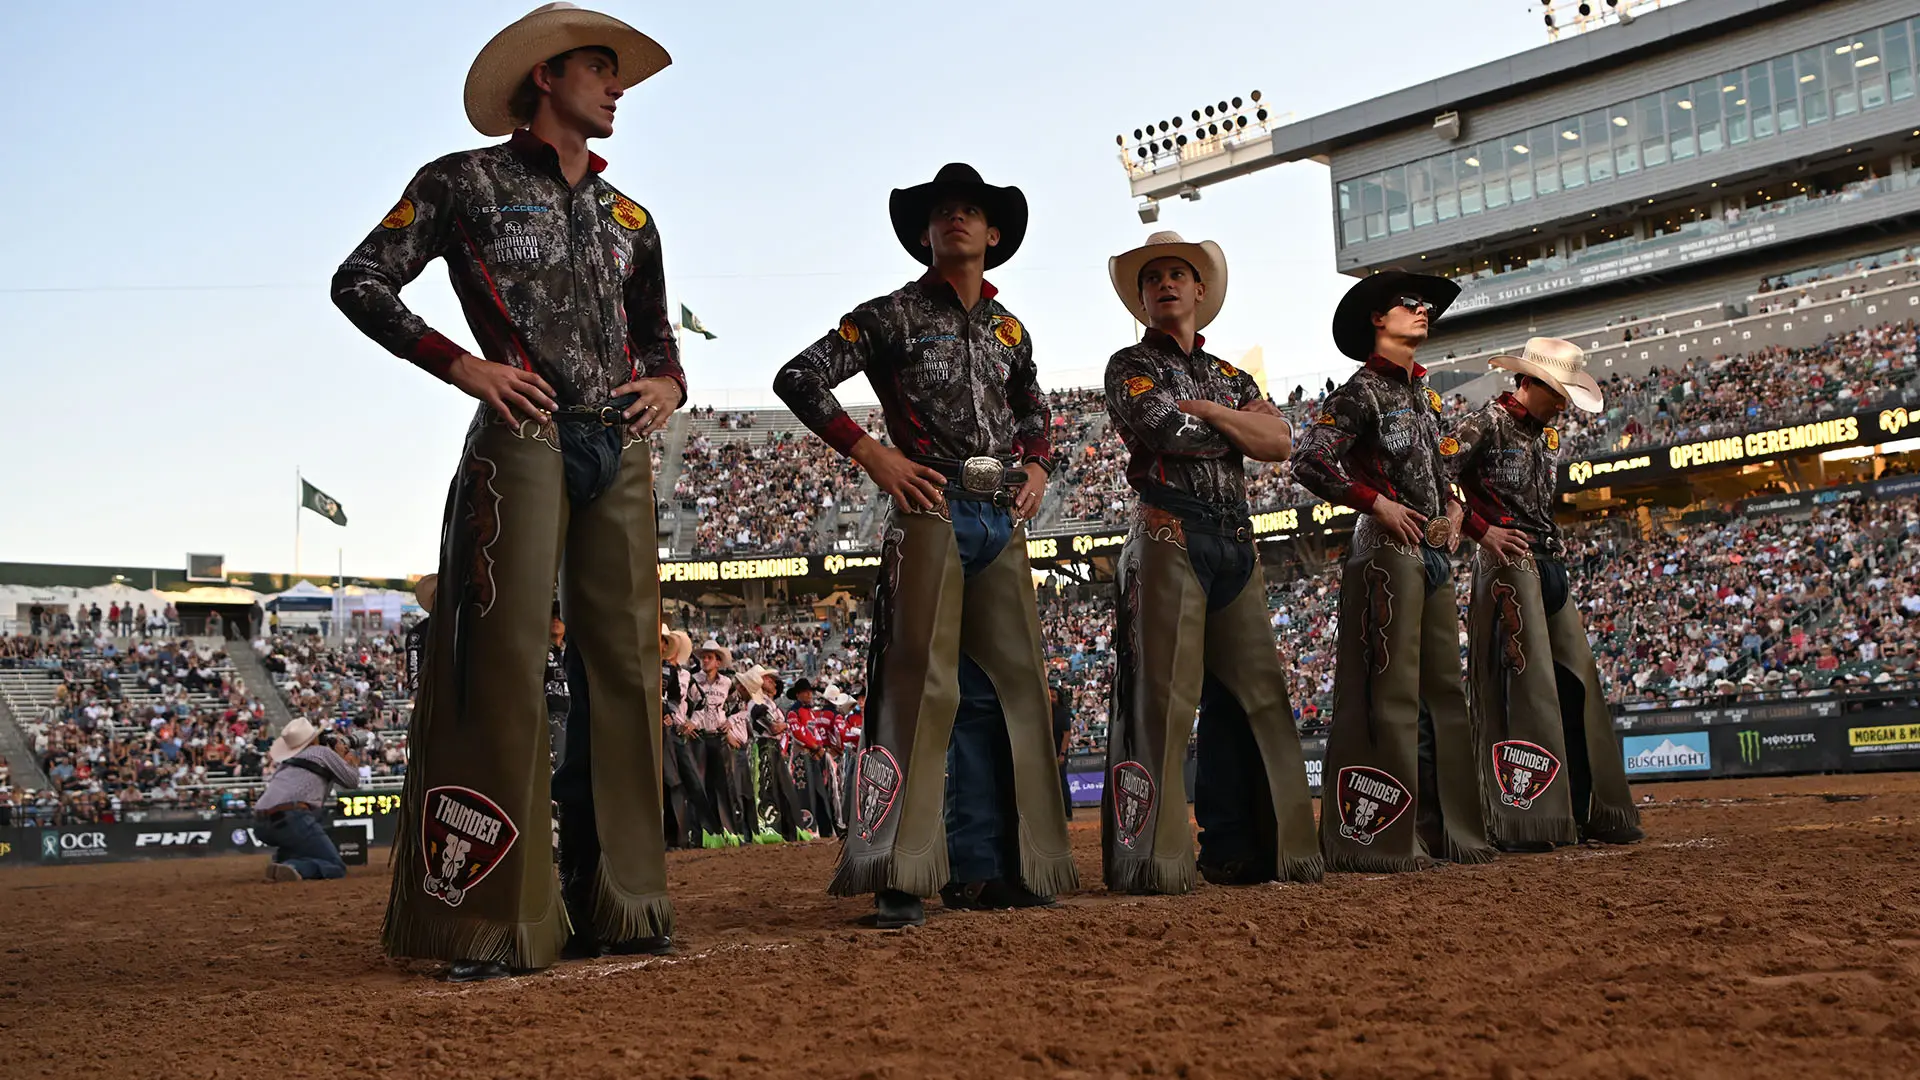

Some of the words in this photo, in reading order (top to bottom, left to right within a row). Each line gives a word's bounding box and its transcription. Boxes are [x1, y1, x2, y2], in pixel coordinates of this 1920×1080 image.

[482, 204, 549, 214] EZ-ACCESS
[494, 235, 539, 251] REDHEAD
[496, 247, 540, 263] RANCH
[1498, 286, 1532, 301] SUITE
[1538, 276, 1573, 293] LEVEL
[1669, 436, 1744, 469] OPENING
[1744, 416, 1859, 457] CEREMONIES
[1593, 455, 1651, 475] RAM
[1250, 508, 1299, 534] MONIES
[720, 557, 809, 580] CEREMONIES
[1762, 732, 1816, 745] MONSTER
[1854, 729, 1897, 743] MORGAN
[1899, 727, 1907, 740] &
[1502, 745, 1551, 772] THUNDER
[862, 754, 895, 791] THUNDER
[1120, 768, 1150, 801] THUNDER
[1348, 771, 1402, 805] THUNDER
[435, 794, 503, 846] THUNDER
[60, 832, 108, 849] OCR
